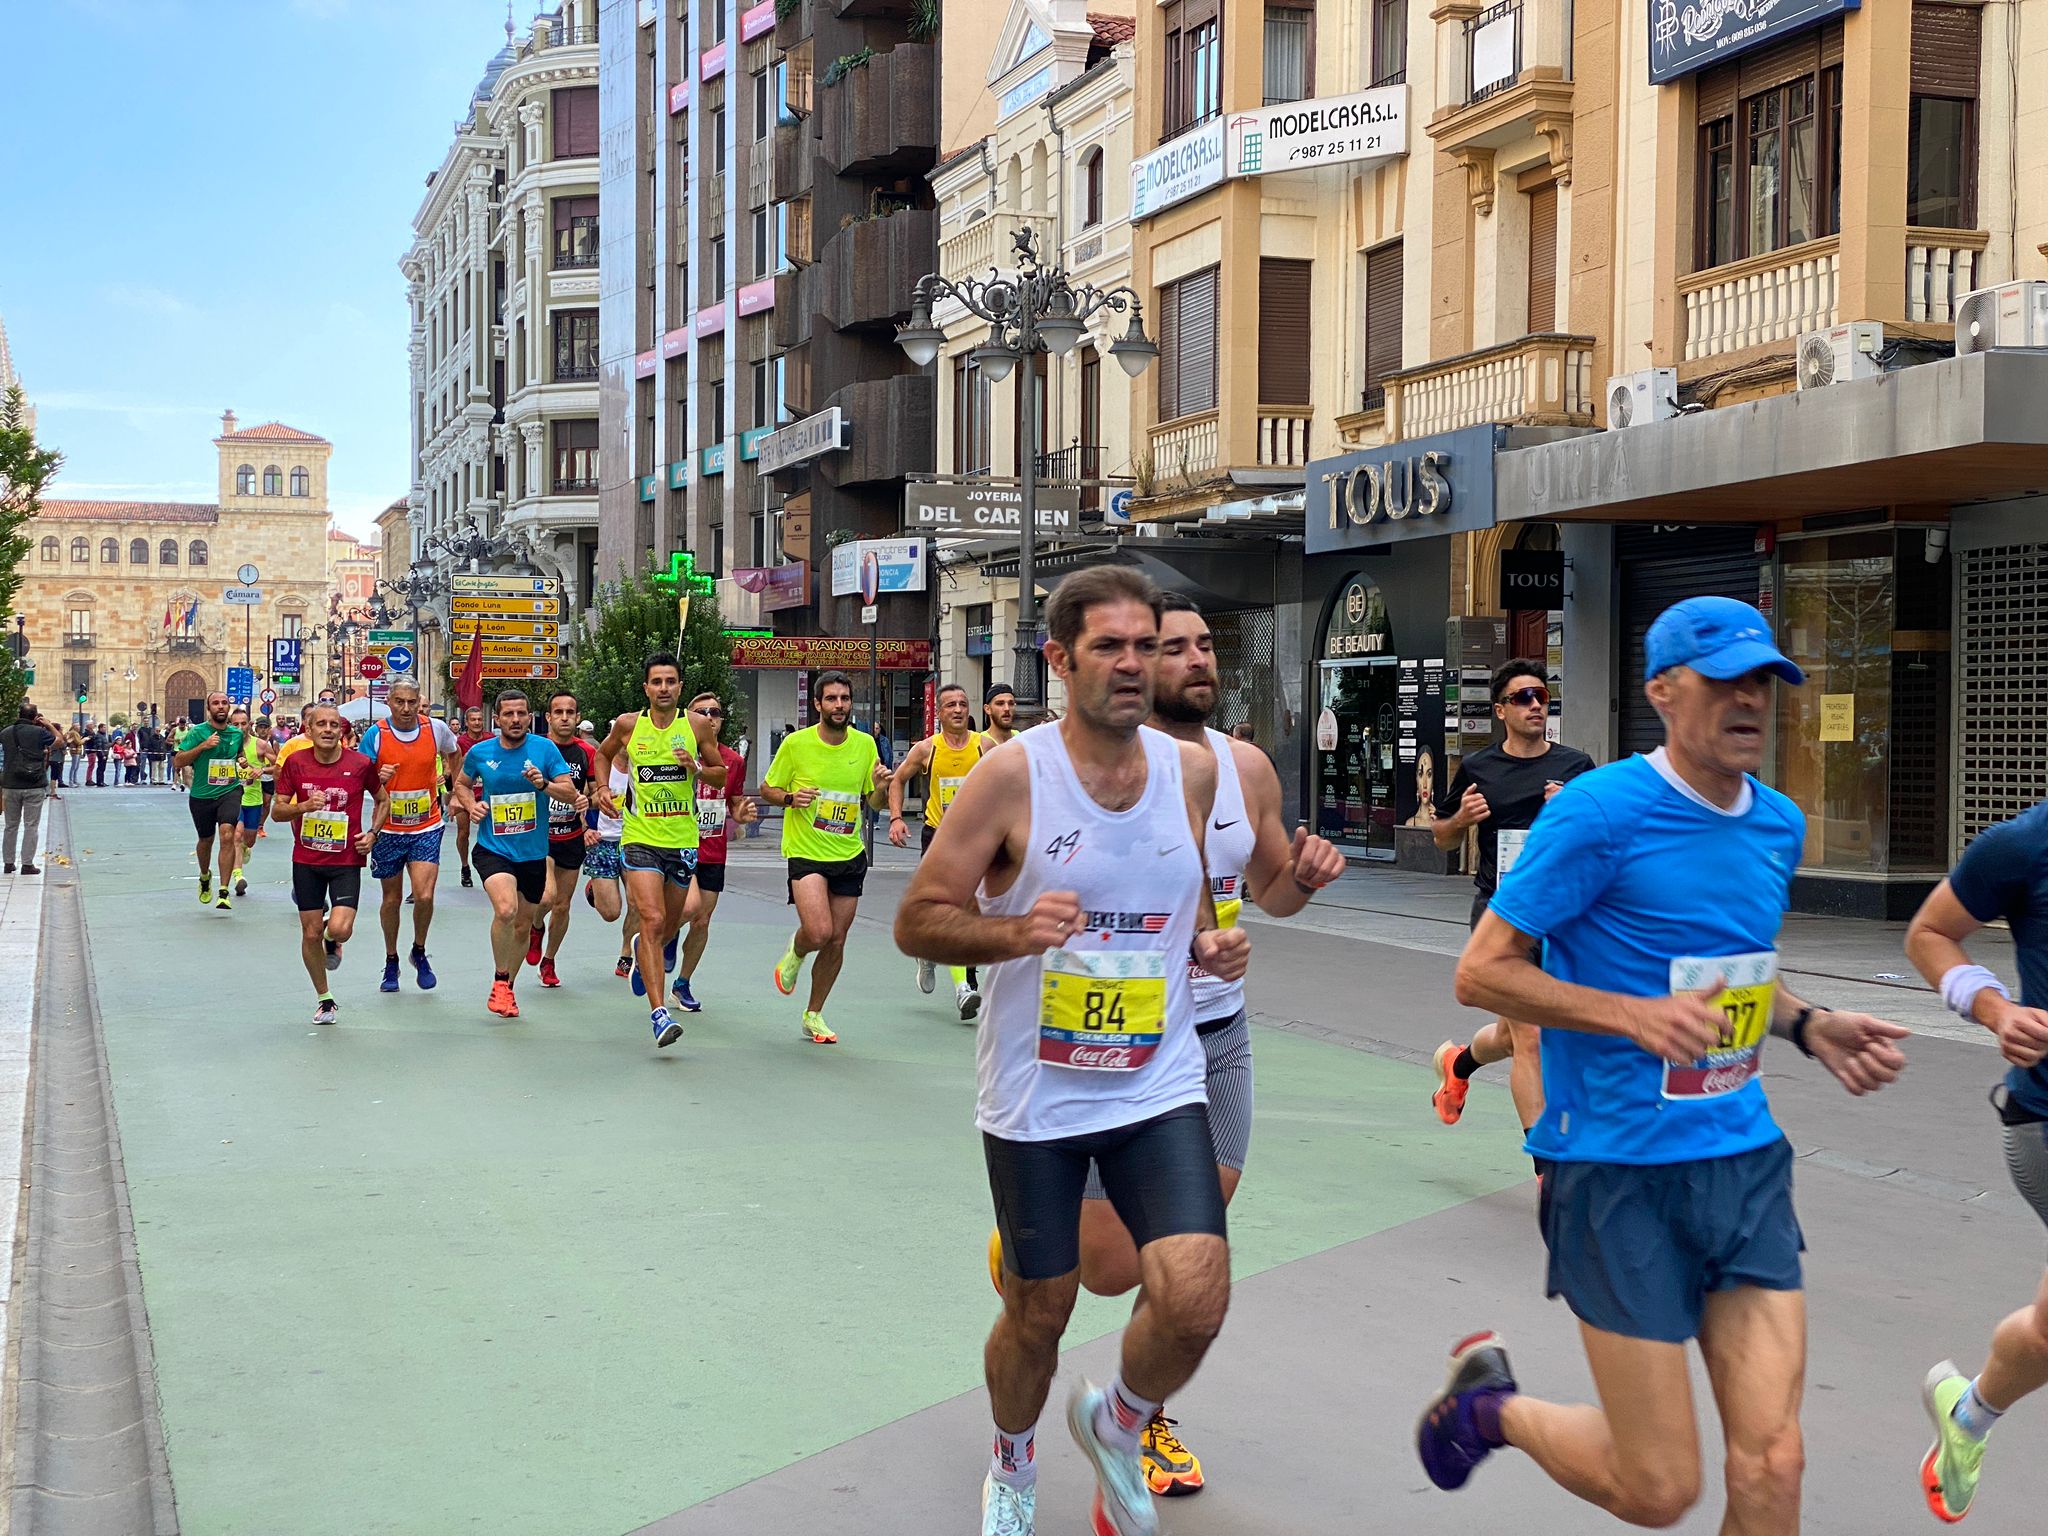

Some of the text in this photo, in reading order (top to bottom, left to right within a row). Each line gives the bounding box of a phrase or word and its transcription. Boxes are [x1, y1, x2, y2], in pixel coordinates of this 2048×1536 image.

[1301, 135, 1382, 159] 987 25 11 21
[967, 491, 1022, 502] JOYERIA
[1322, 450, 1452, 529] TOUS
[919, 505, 1069, 527] DEL CAREN
[1507, 572, 1559, 588] TOUS
[226, 589, 260, 600] Cámara
[455, 600, 501, 609] Conde Luna
[1349, 594, 1363, 613] BE
[968, 625, 992, 637] ESTRELLA
[493, 645, 523, 653] Antonio
[732, 639, 906, 652] ROYAL TANDOORI
[1330, 633, 1385, 654] BE BEAUTY
[361, 663, 382, 671] STOP
[483, 666, 506, 674] Conde
[1380, 714, 1393, 732] BE
[218, 767, 229, 777] 181
[404, 802, 418, 814] 118
[505, 806, 524, 821] 157
[832, 806, 847, 821] 115
[314, 823, 333, 839] 134
[1045, 828, 1081, 862] 44
[1084, 991, 1126, 1032] 84
